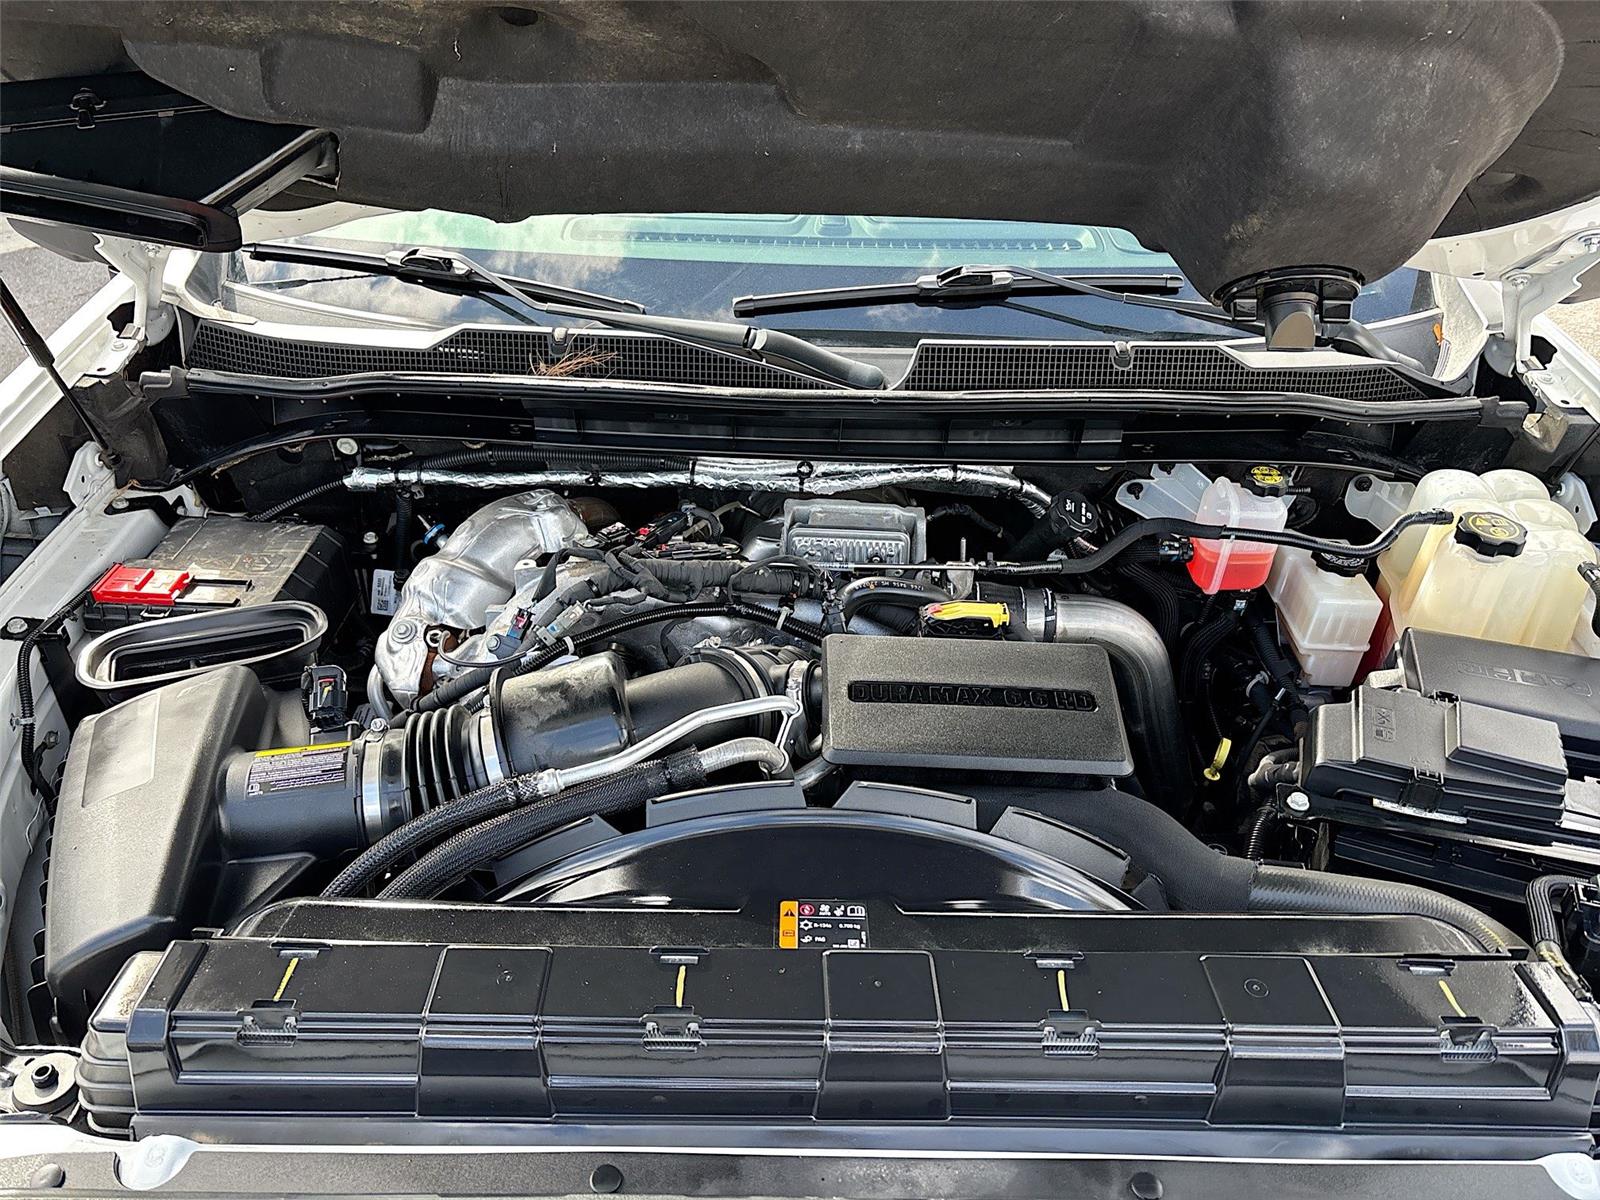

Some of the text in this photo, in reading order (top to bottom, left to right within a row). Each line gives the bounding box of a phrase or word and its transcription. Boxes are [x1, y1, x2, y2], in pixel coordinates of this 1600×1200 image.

[850, 683, 1095, 711] DURAMAX 6.6 HD
